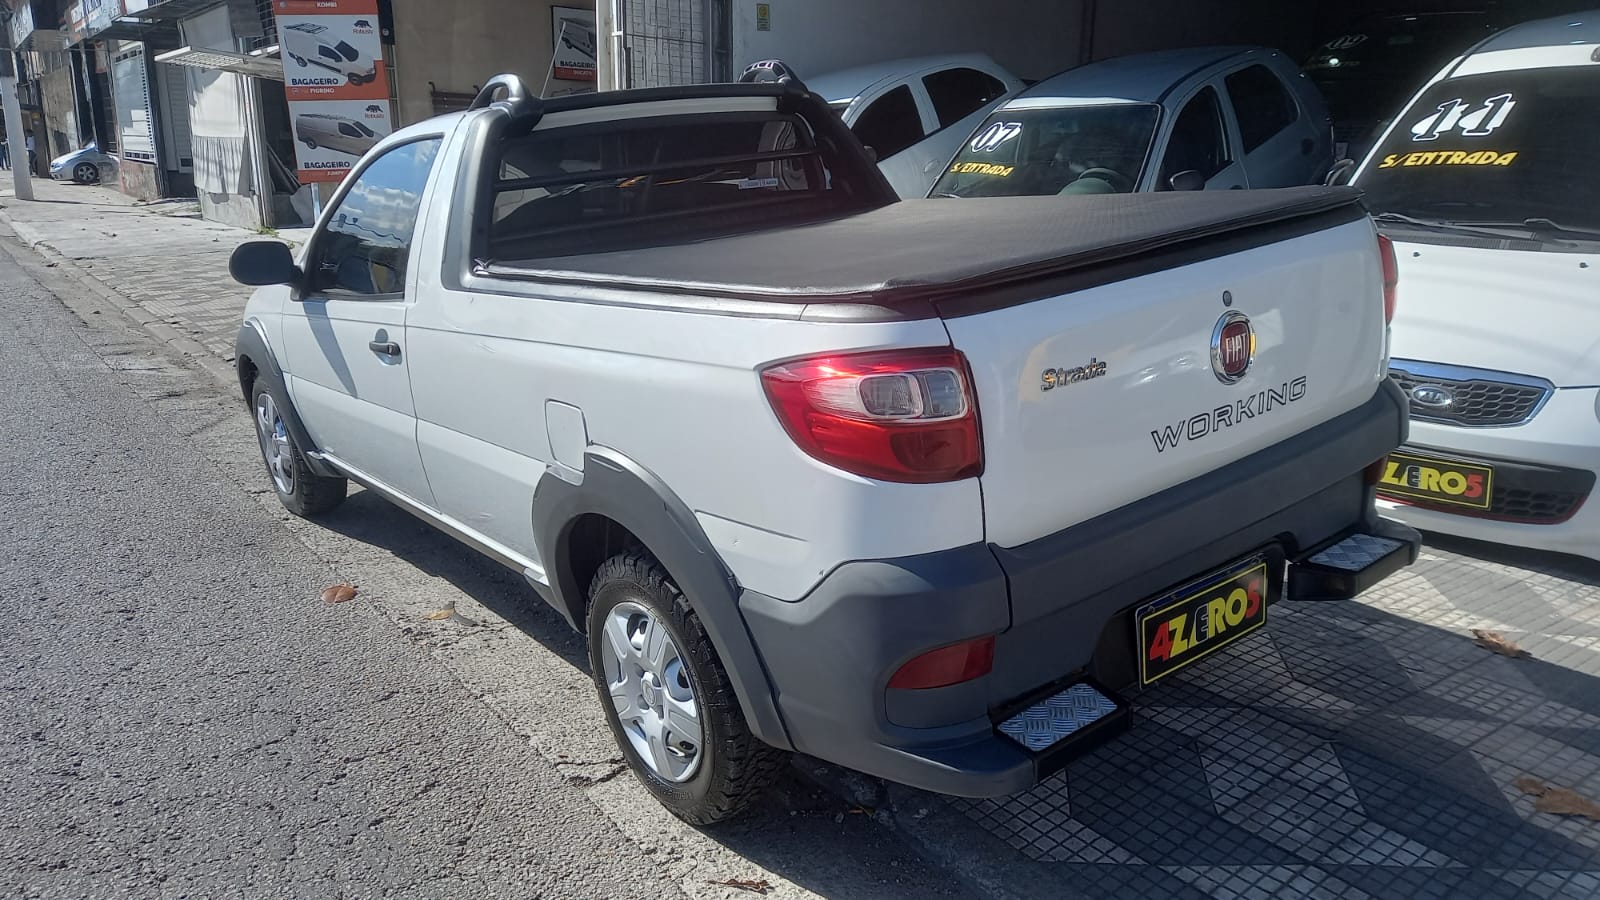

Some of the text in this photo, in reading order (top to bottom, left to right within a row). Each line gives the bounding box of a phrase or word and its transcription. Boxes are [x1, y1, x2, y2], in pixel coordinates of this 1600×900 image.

[292, 78, 339, 86] BAGAGEIRO
[970, 121, 1023, 152] 07
[304, 161, 351, 169] BAGAGEIRO
[1225, 332, 1249, 364] FIAT
[1041, 357, 1107, 392] Strada
[1151, 376, 1307, 453] WORKING
[1380, 461, 1483, 498] ZERO5
[1150, 578, 1261, 662] 4ZERO5
